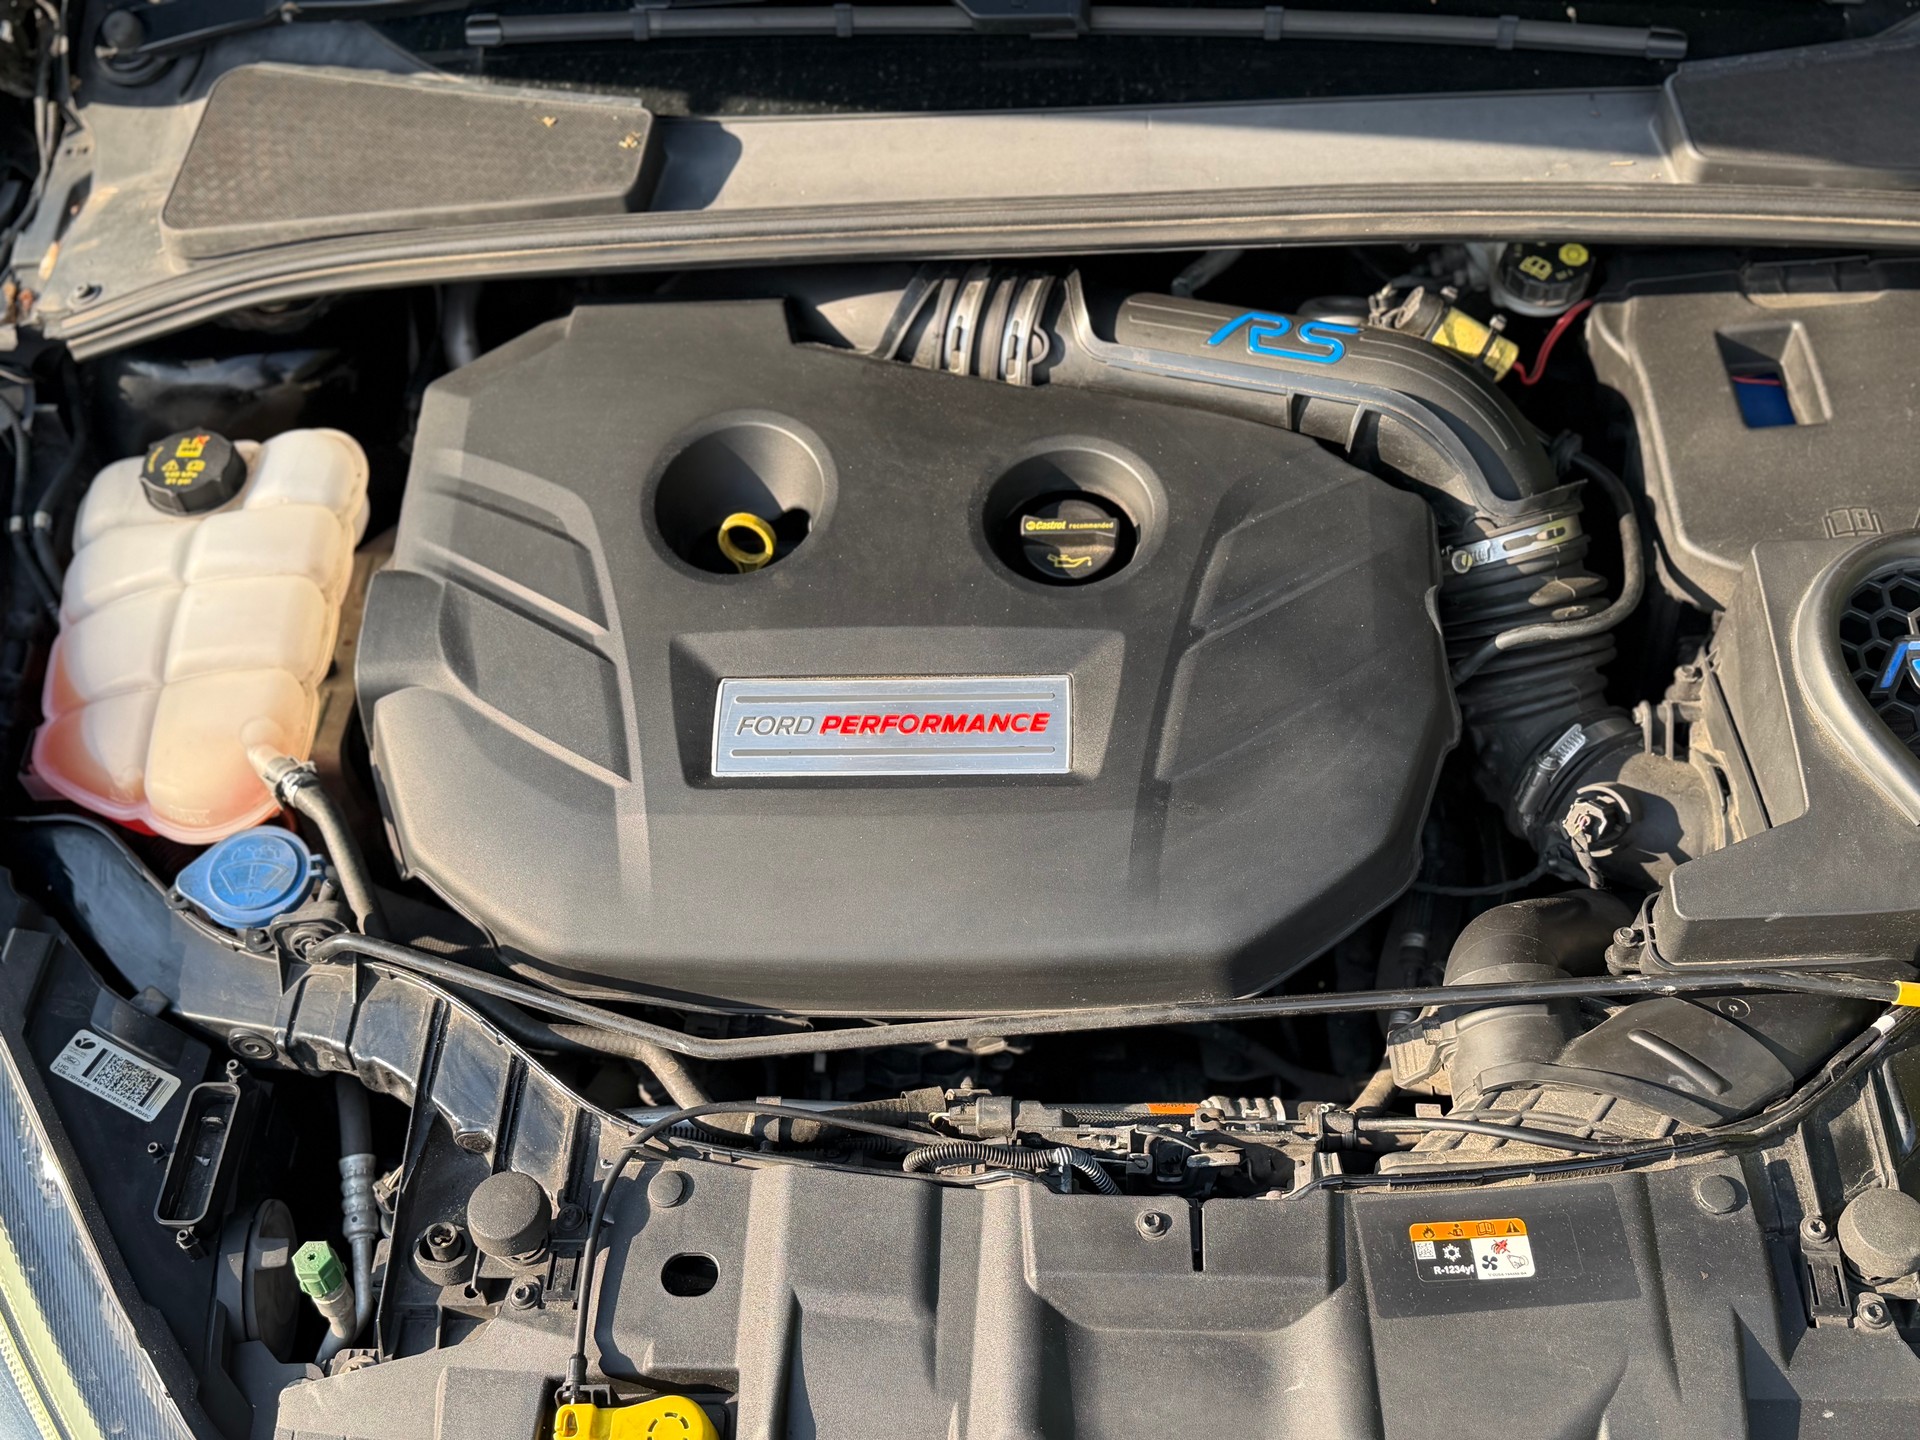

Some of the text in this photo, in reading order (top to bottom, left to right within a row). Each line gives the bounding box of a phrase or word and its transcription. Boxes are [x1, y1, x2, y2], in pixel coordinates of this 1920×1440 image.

[1207, 311, 1360, 364] RS
[1035, 520, 1114, 531] Castrol recommended
[735, 711, 1052, 737] FORD PERFORMANCE
[1433, 1264, 1475, 1276] R-1234yf
